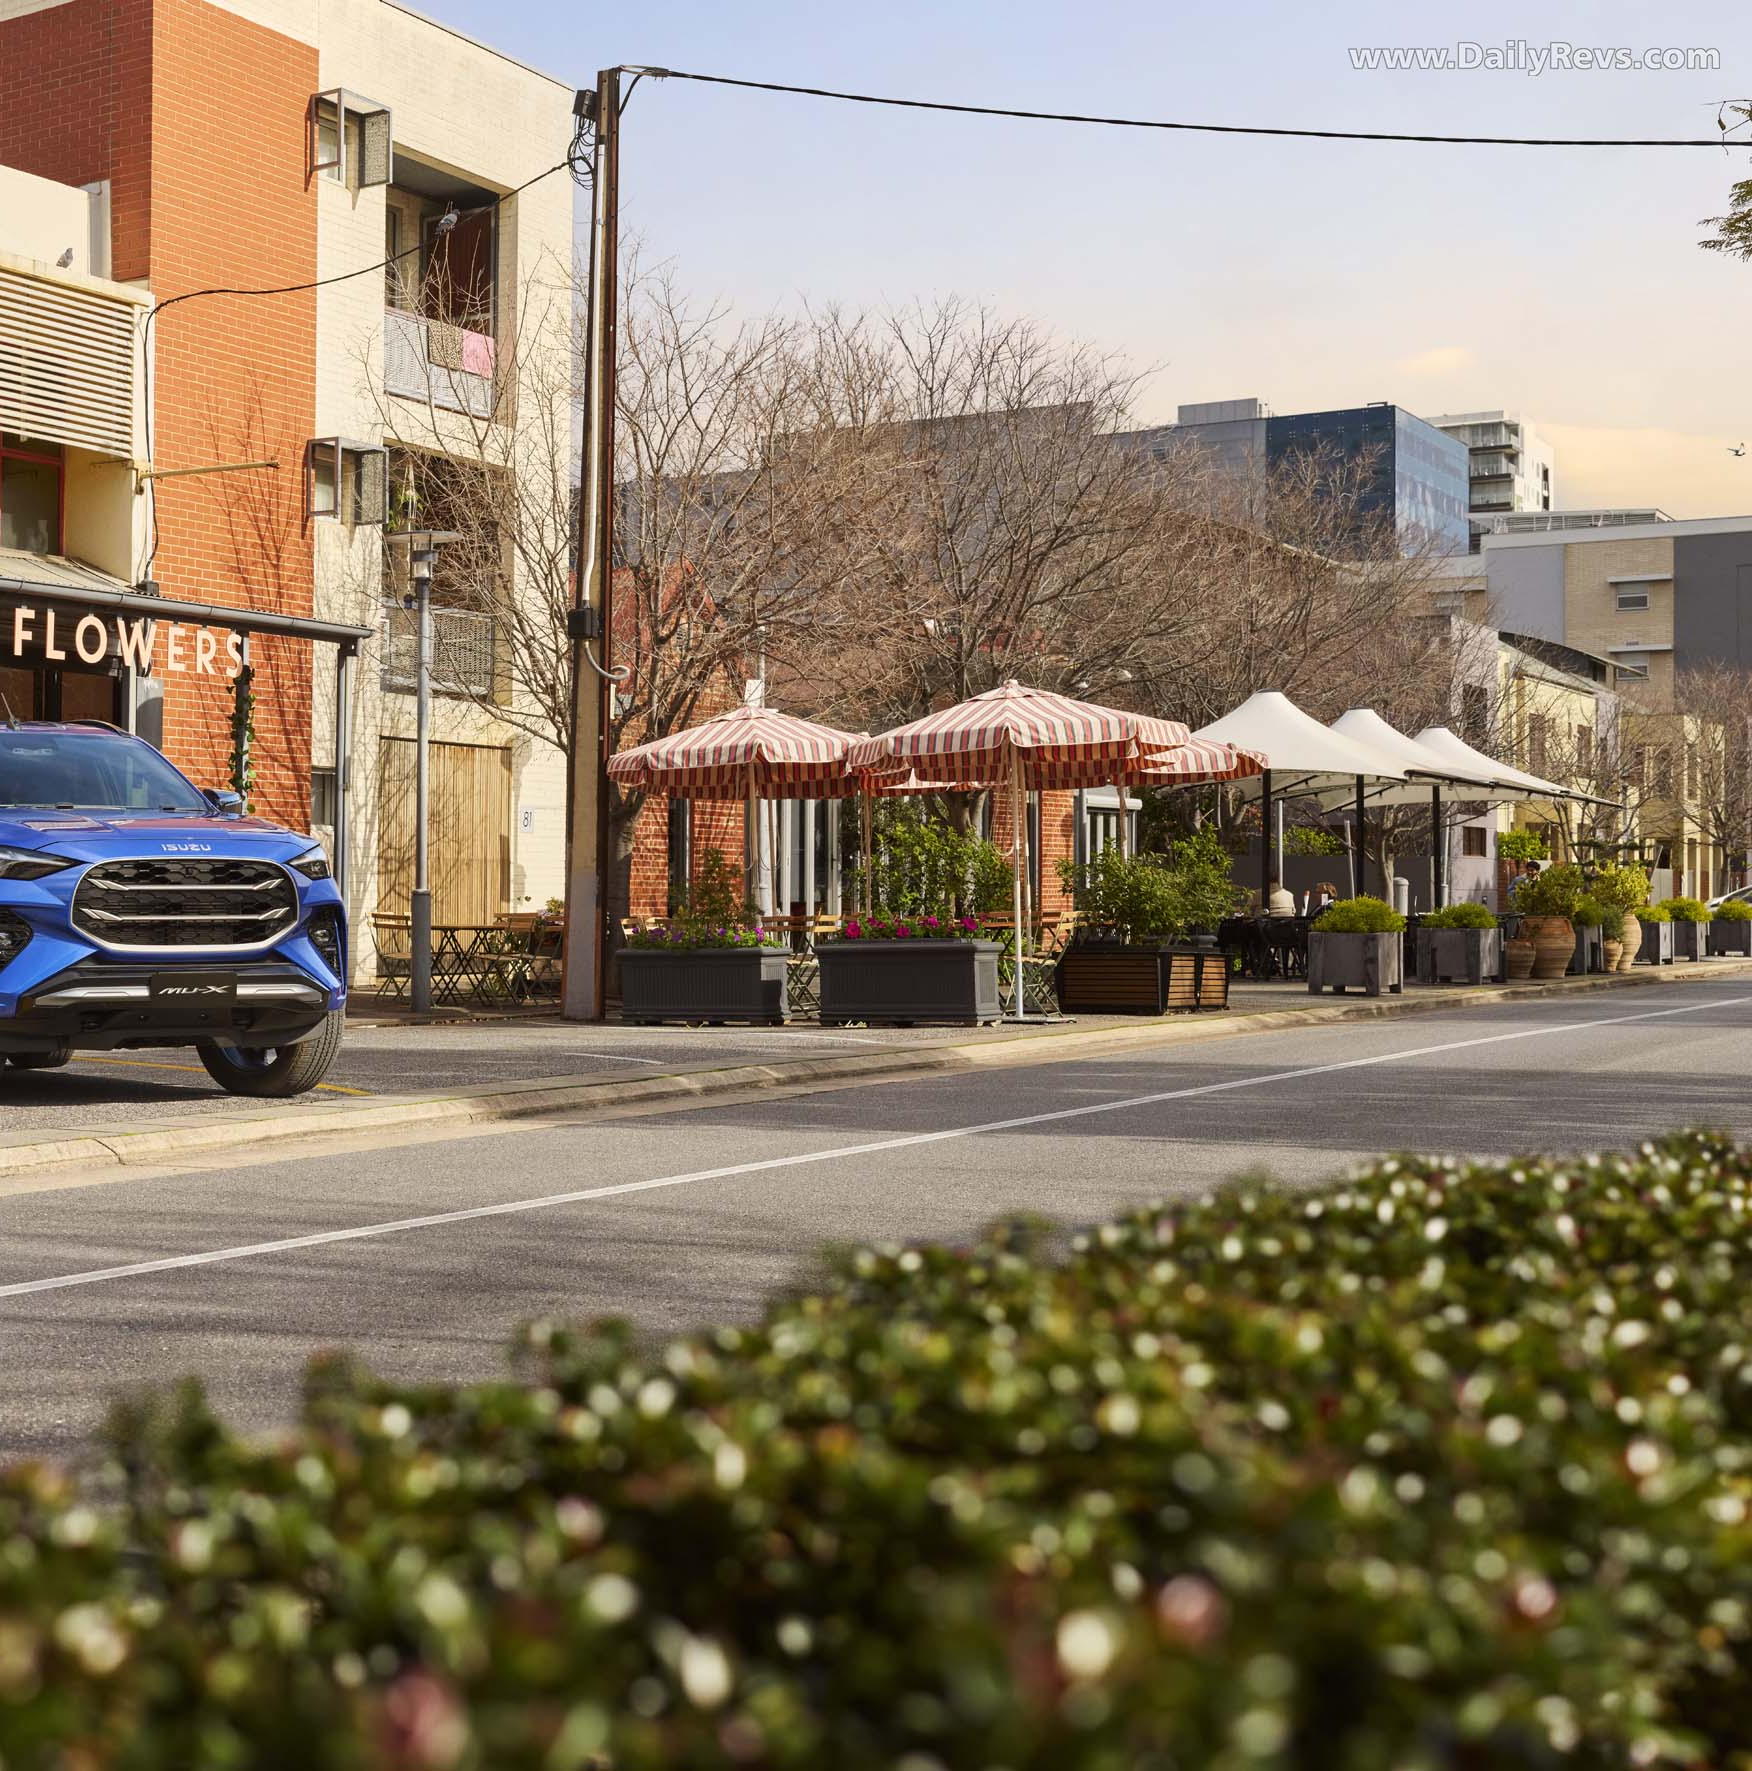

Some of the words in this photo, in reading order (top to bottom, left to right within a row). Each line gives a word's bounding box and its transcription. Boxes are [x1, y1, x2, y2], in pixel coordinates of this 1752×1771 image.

[13, 606, 243, 679] FLOWERS
[522, 811, 533, 828] 81
[160, 843, 212, 852] ISUZU
